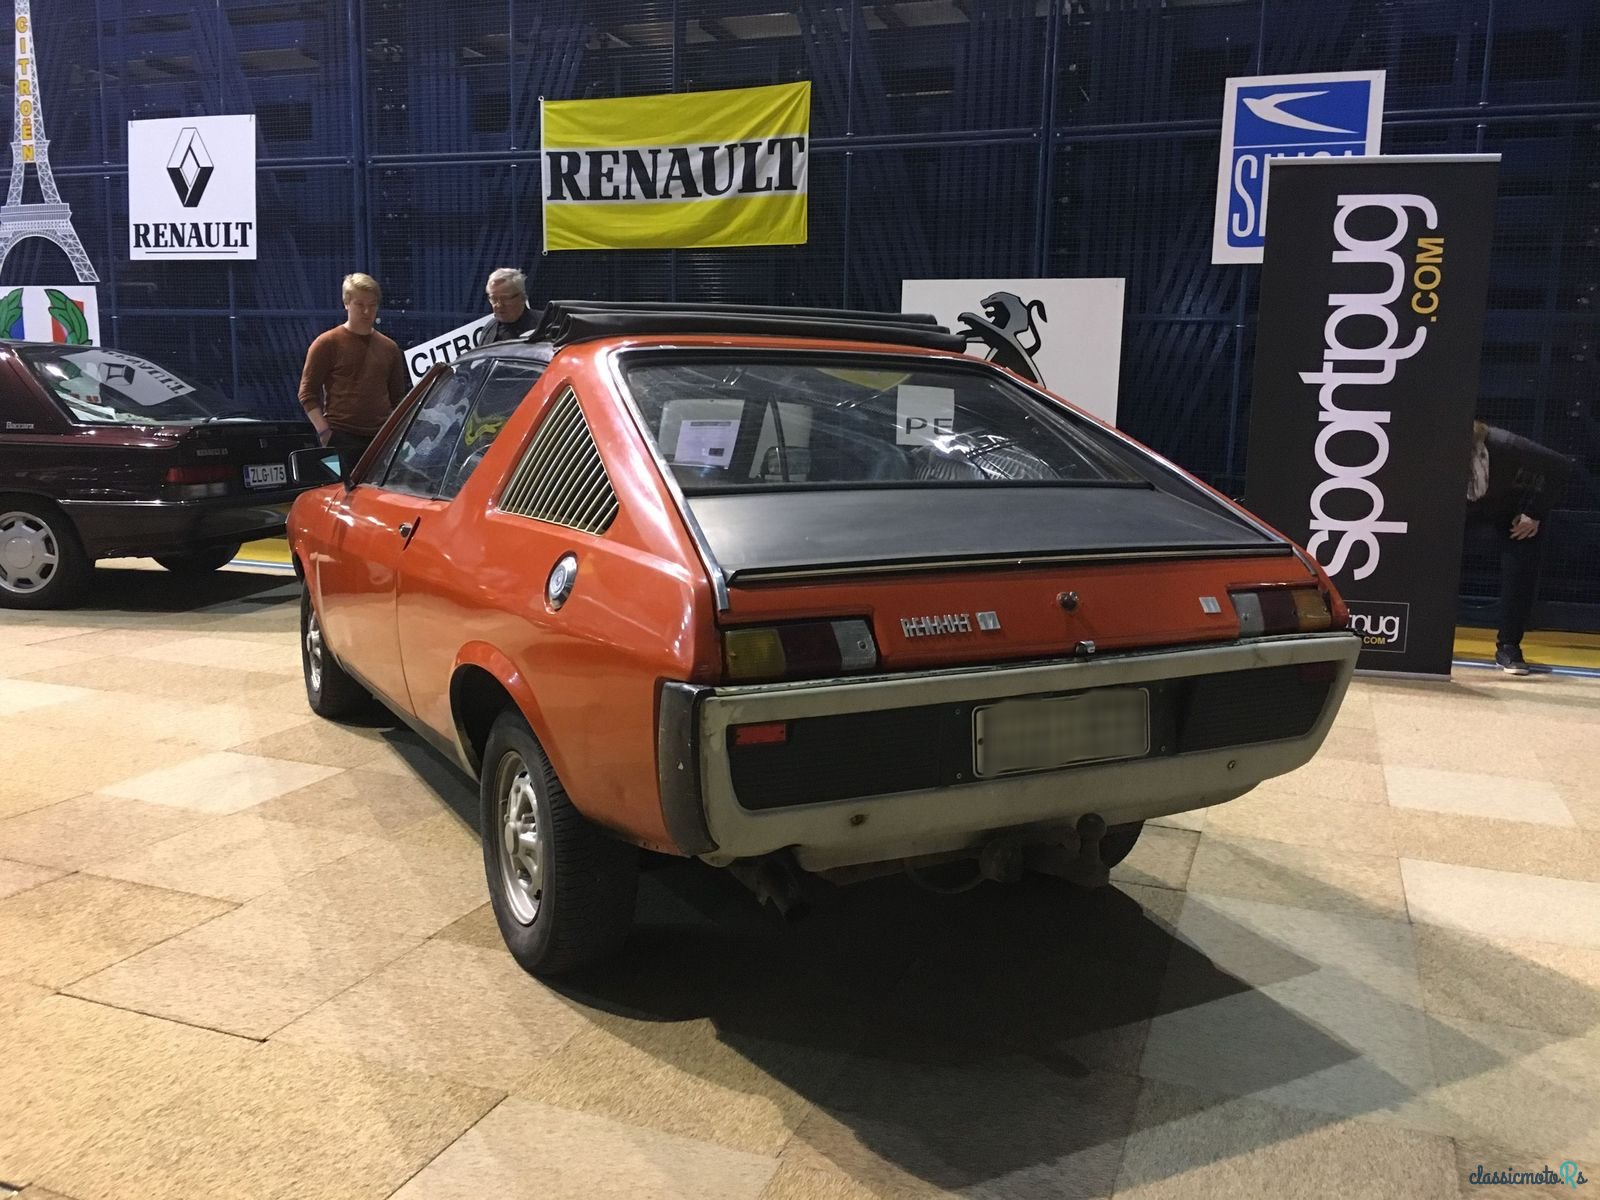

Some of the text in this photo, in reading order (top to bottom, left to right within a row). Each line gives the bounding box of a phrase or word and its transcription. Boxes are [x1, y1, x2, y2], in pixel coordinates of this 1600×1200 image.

[16, 16, 34, 161] CITROËN
[546, 137, 805, 202] RENAULT
[133, 222, 252, 248] RENAULT
[1411, 237, 1445, 322] .COM
[1297, 193, 1438, 581] sportpug
[250, 466, 285, 484] ZLG-175
[900, 613, 972, 637] RENAULT
